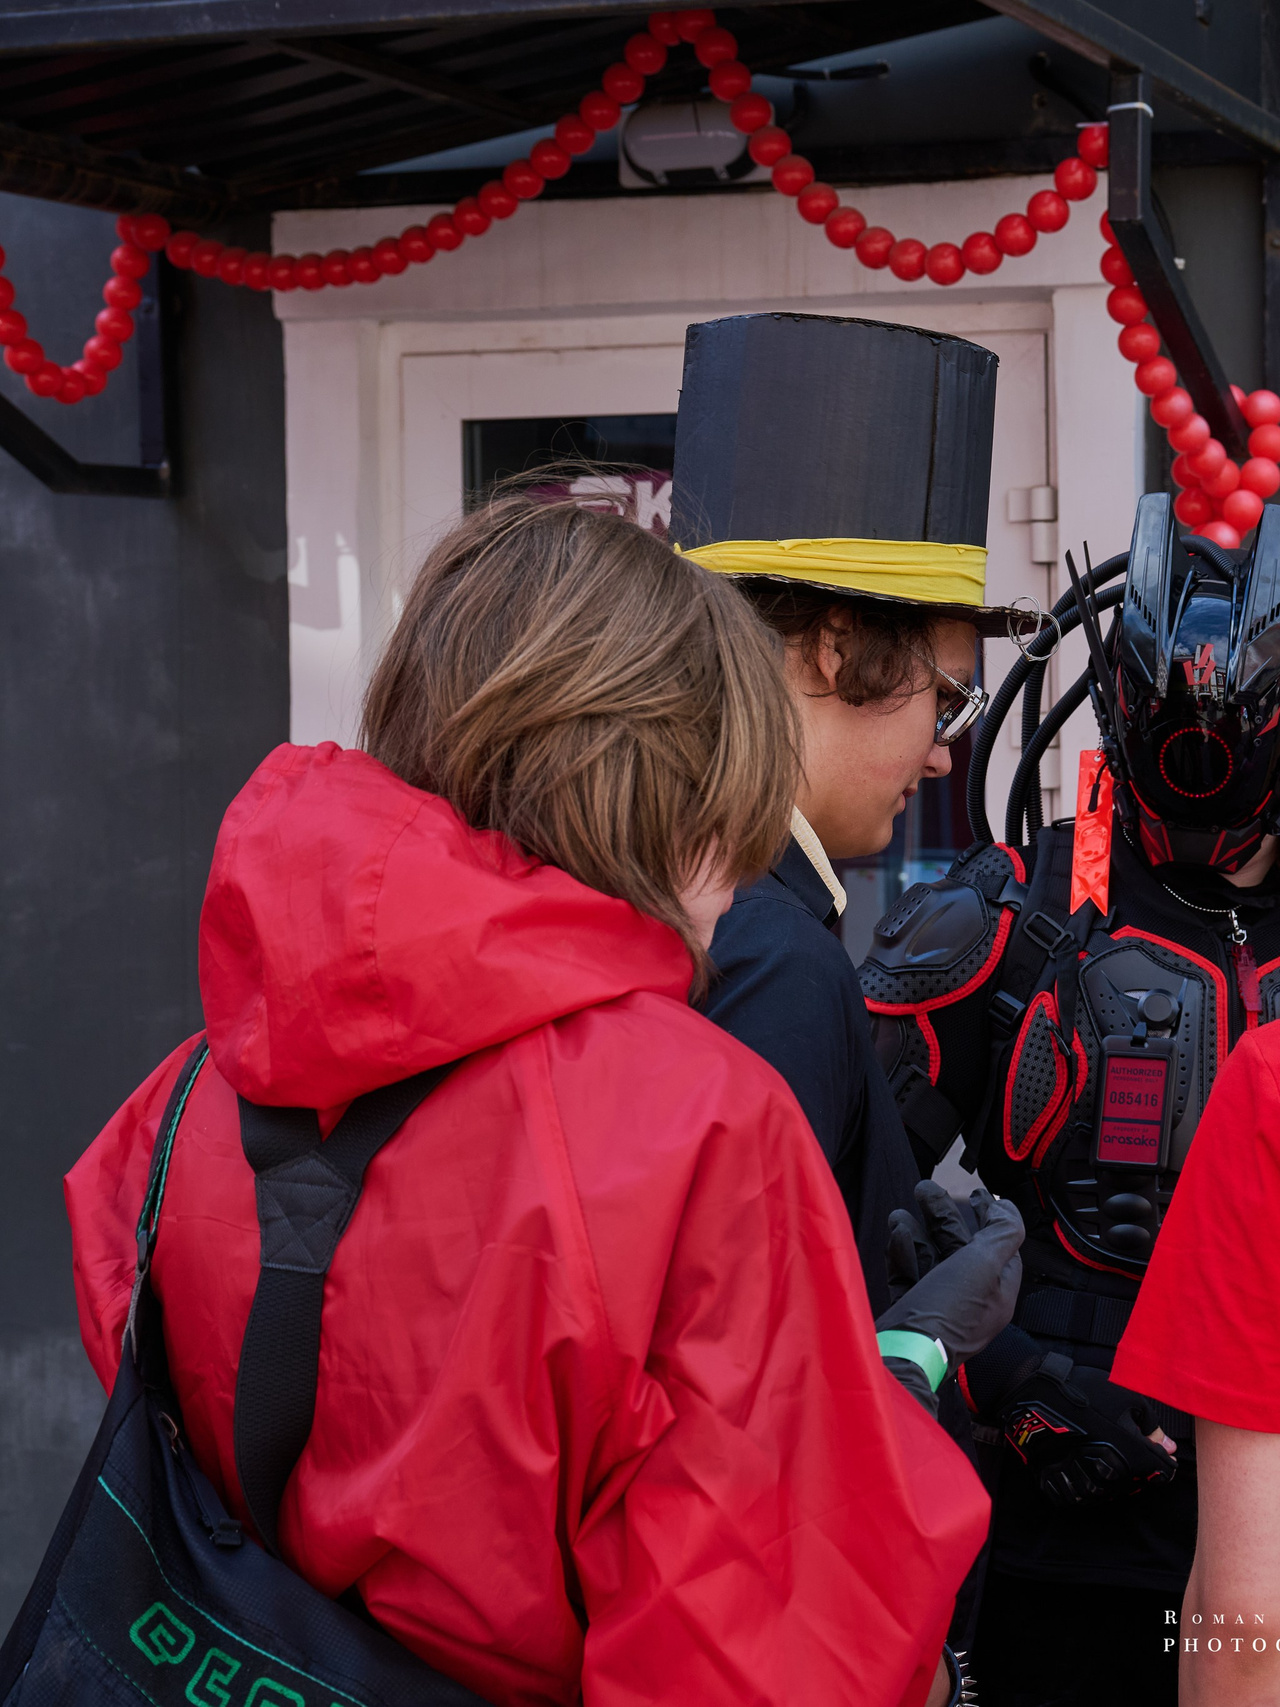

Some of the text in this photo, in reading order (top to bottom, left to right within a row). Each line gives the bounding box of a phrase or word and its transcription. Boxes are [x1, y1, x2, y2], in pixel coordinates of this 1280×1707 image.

[1110, 1067, 1163, 1077] AUTHORIZED
[1109, 1091, 1159, 1107] 085416
[1103, 1135, 1157, 1147] arasaka
